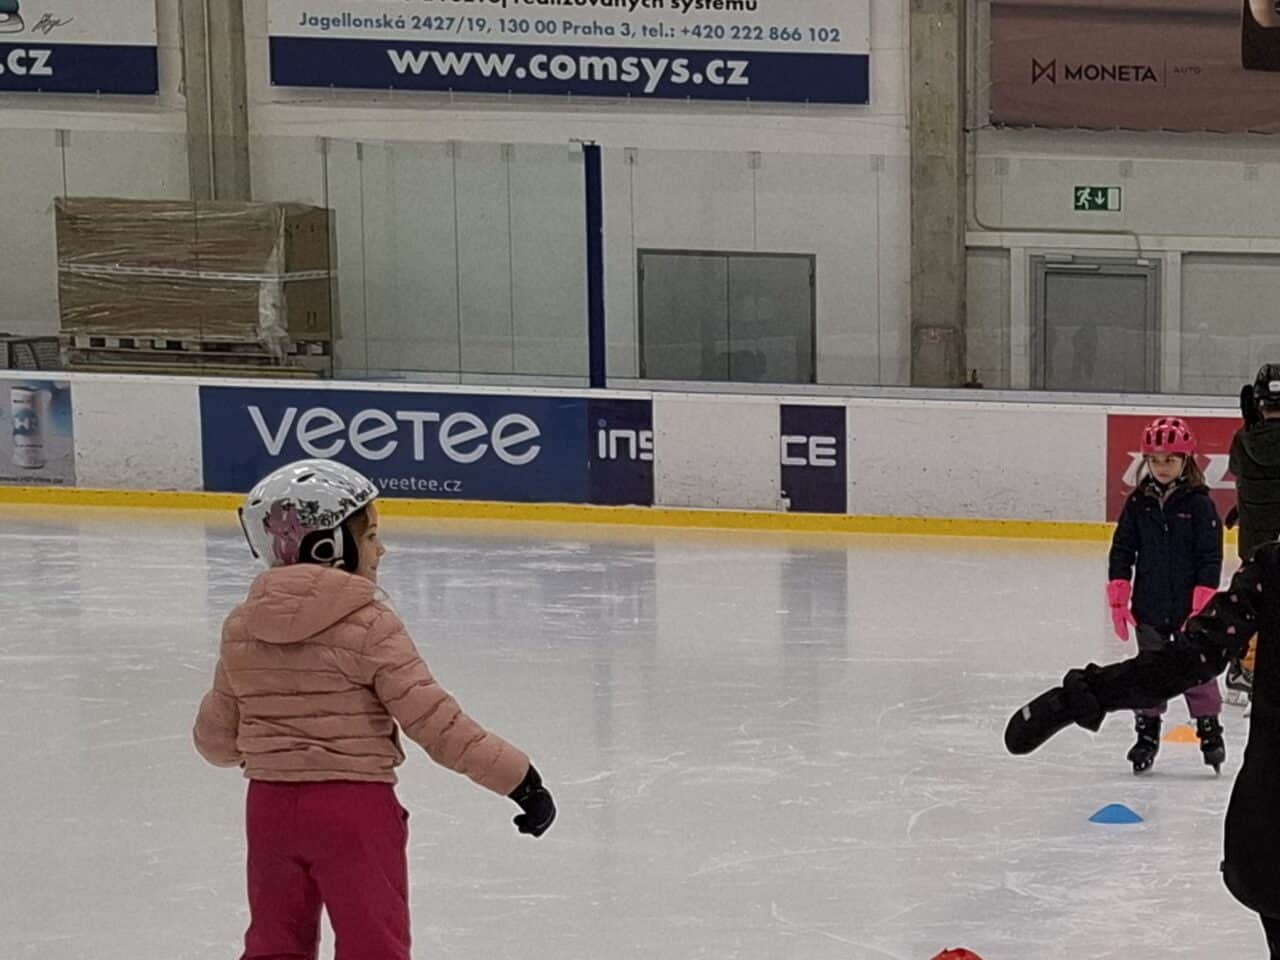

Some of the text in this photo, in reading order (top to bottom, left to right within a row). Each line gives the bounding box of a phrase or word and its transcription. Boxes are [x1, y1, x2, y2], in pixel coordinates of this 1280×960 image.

[300, 13, 840, 42] Jagellonská 2427/19, 130 00 Praha 3, tel.: +420 222 866 102
[387, 49, 749, 93] www.comsys.cz
[1064, 64, 1157, 82] MONETA
